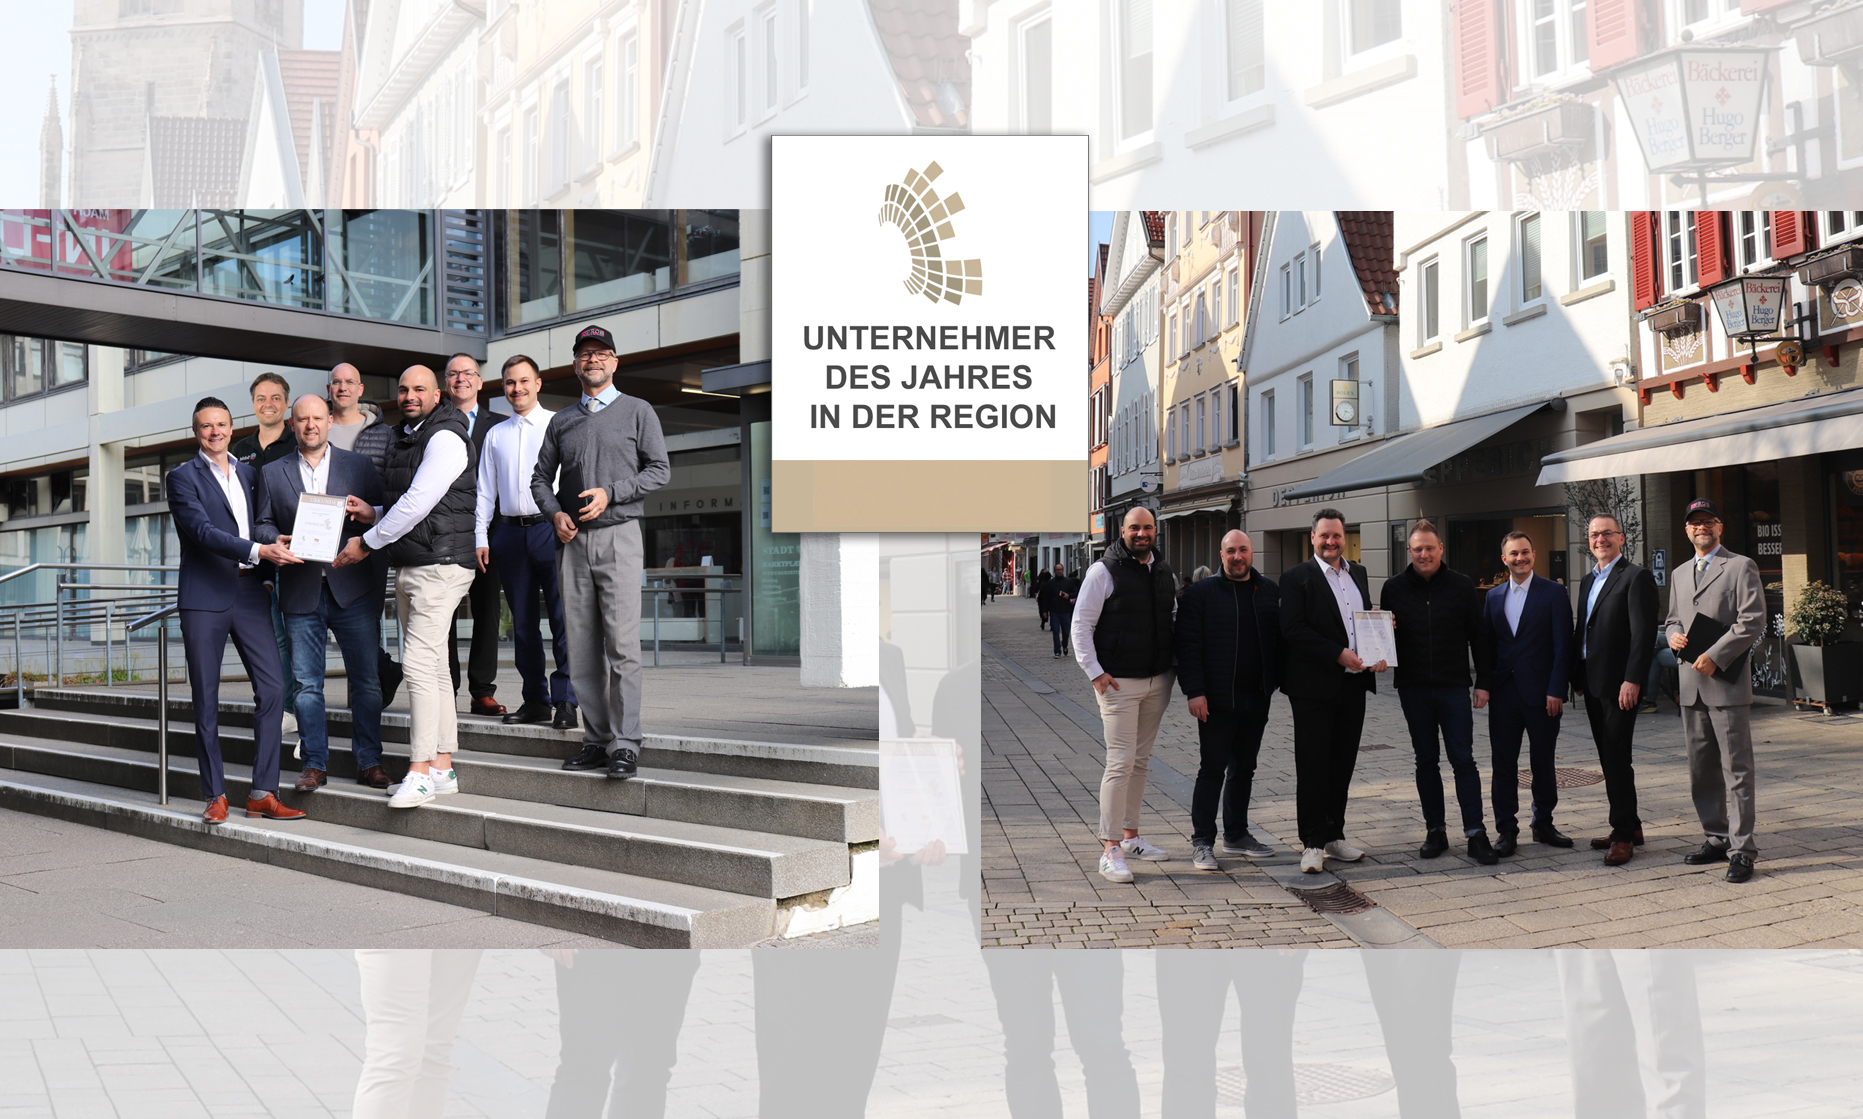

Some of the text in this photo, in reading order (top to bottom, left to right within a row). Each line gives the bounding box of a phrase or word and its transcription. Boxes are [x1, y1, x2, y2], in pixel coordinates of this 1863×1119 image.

[1687, 60, 1758, 82] Bäckerei
[1624, 63, 1679, 98] Bäckerei
[1646, 116, 1678, 136] Hugo
[1702, 107, 1744, 132] Hugo
[1648, 134, 1685, 157] Berger
[1699, 128, 1746, 150] Berger
[1715, 284, 1742, 301] Bäckerei
[1745, 282, 1780, 293] Bäckerei
[1725, 310, 1742, 320] Hugo
[1753, 305, 1774, 317] Hugo
[1727, 319, 1745, 329] Berger
[1751, 315, 1775, 326] Berger
[660, 498, 742, 511] INFORM
[1757, 525, 1770, 537] BIO
[762, 546, 794, 555] STADT
